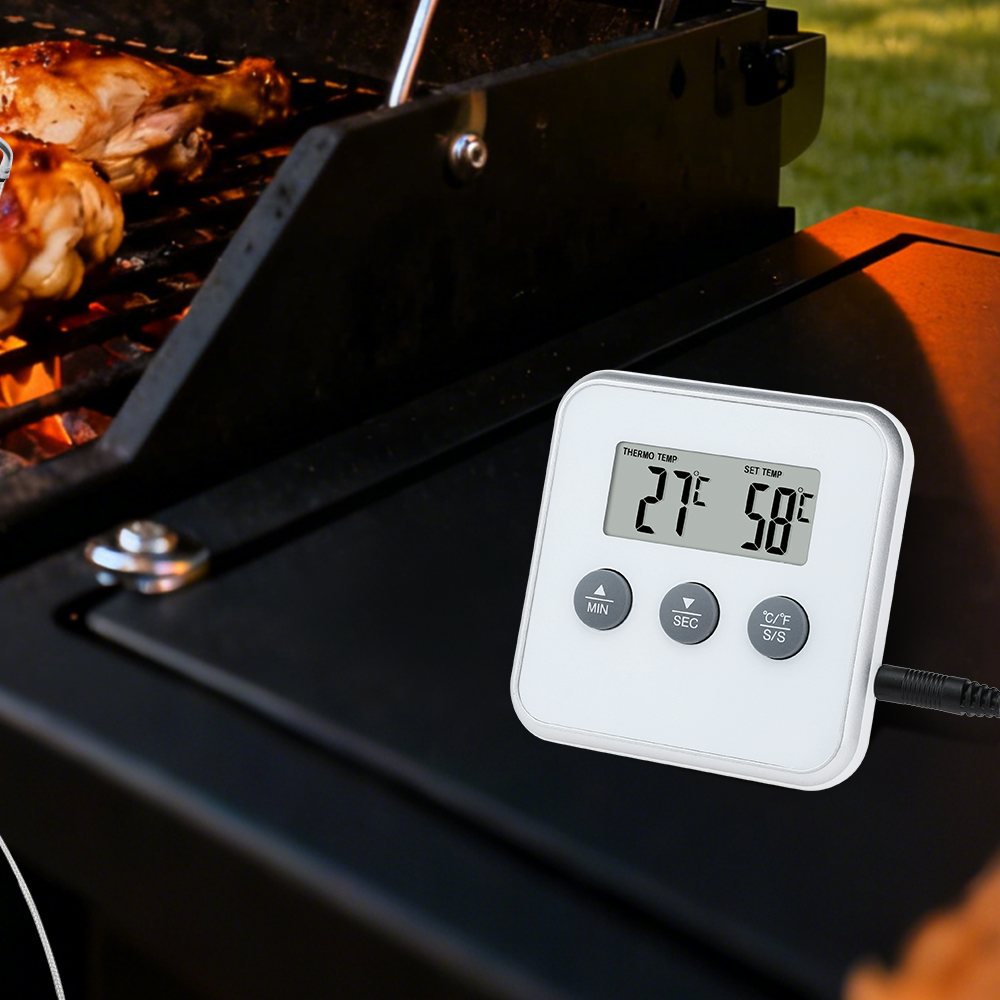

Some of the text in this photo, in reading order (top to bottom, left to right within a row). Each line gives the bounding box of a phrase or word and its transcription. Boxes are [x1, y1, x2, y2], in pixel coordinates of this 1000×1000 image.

[623, 447, 678, 463] THERMO TEMP
[744, 465, 783, 479] SET TEMP
[586, 602, 609, 616] MIN
[673, 615, 699, 630] SEC
[762, 629, 787, 643] S/S
